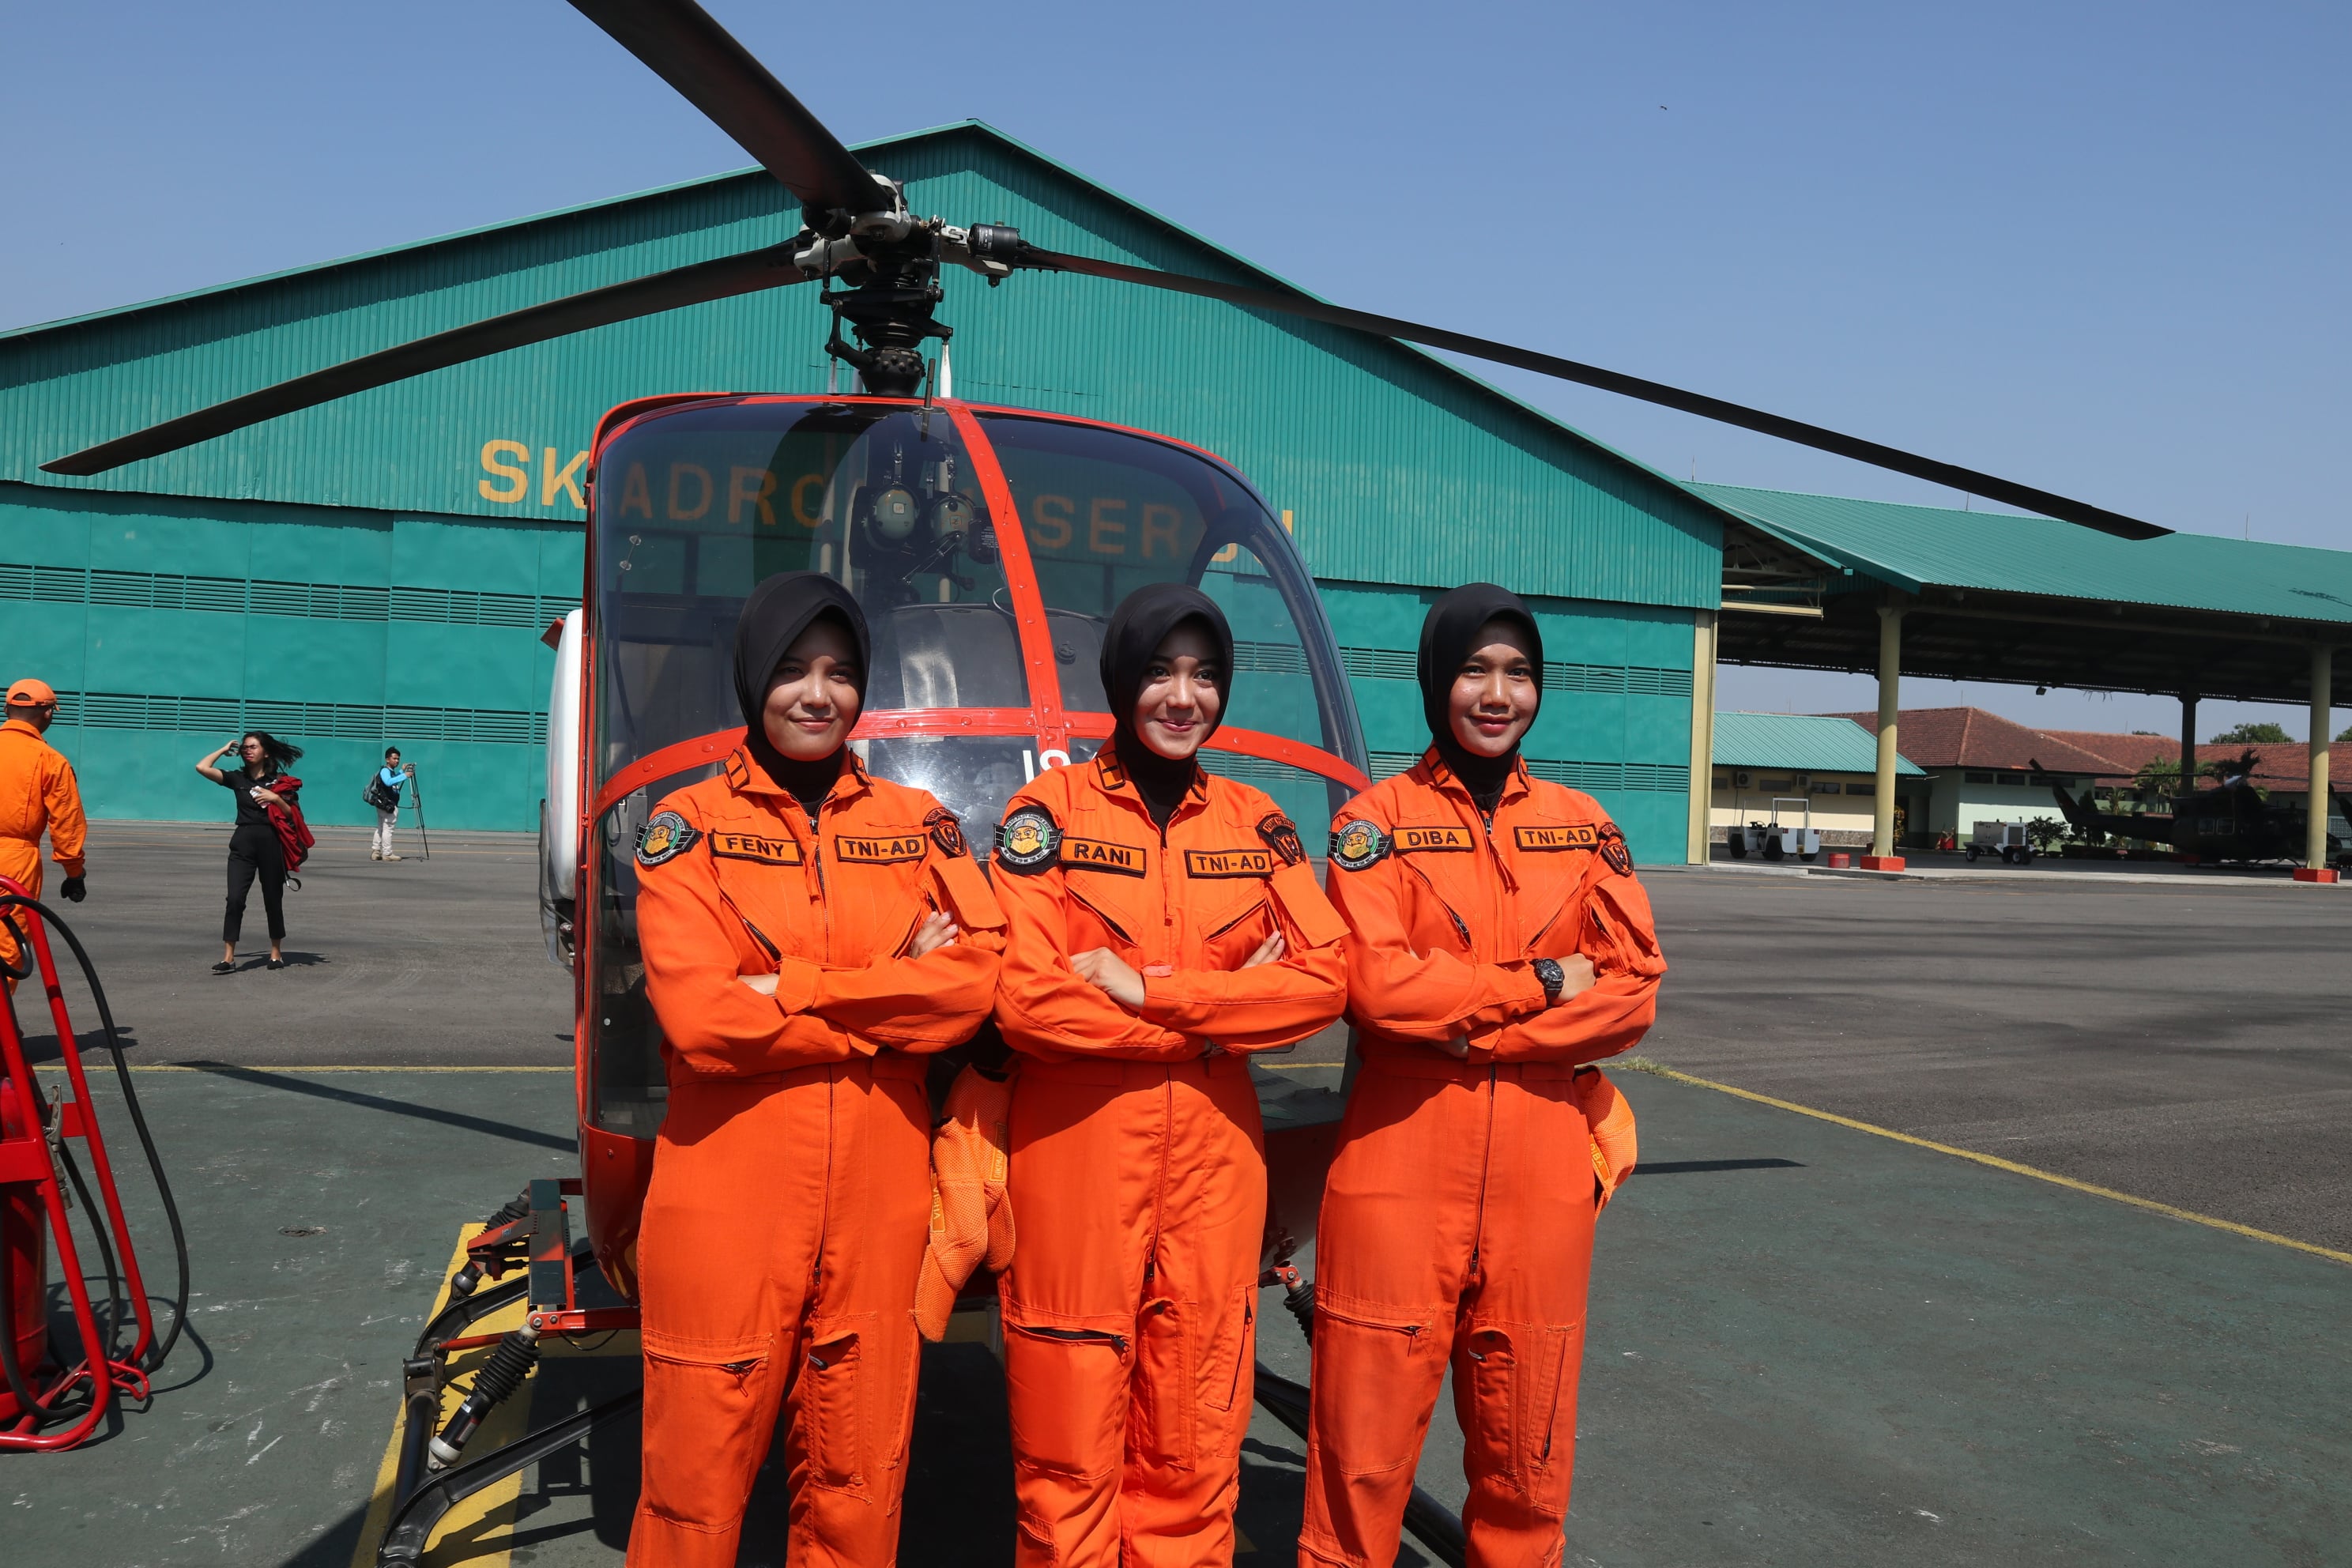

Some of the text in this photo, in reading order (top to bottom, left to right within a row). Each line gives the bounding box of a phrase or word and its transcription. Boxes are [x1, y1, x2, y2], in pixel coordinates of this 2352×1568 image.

[478, 439, 827, 528] SKADRO
[1407, 831, 1459, 846] DIBA
[1525, 829, 1592, 844] TNI-AD
[726, 837, 784, 858] FENY
[845, 840, 919, 854] TNI-AD
[1073, 843, 1131, 865] RANI
[1197, 855, 1266, 870] TNI-AD
